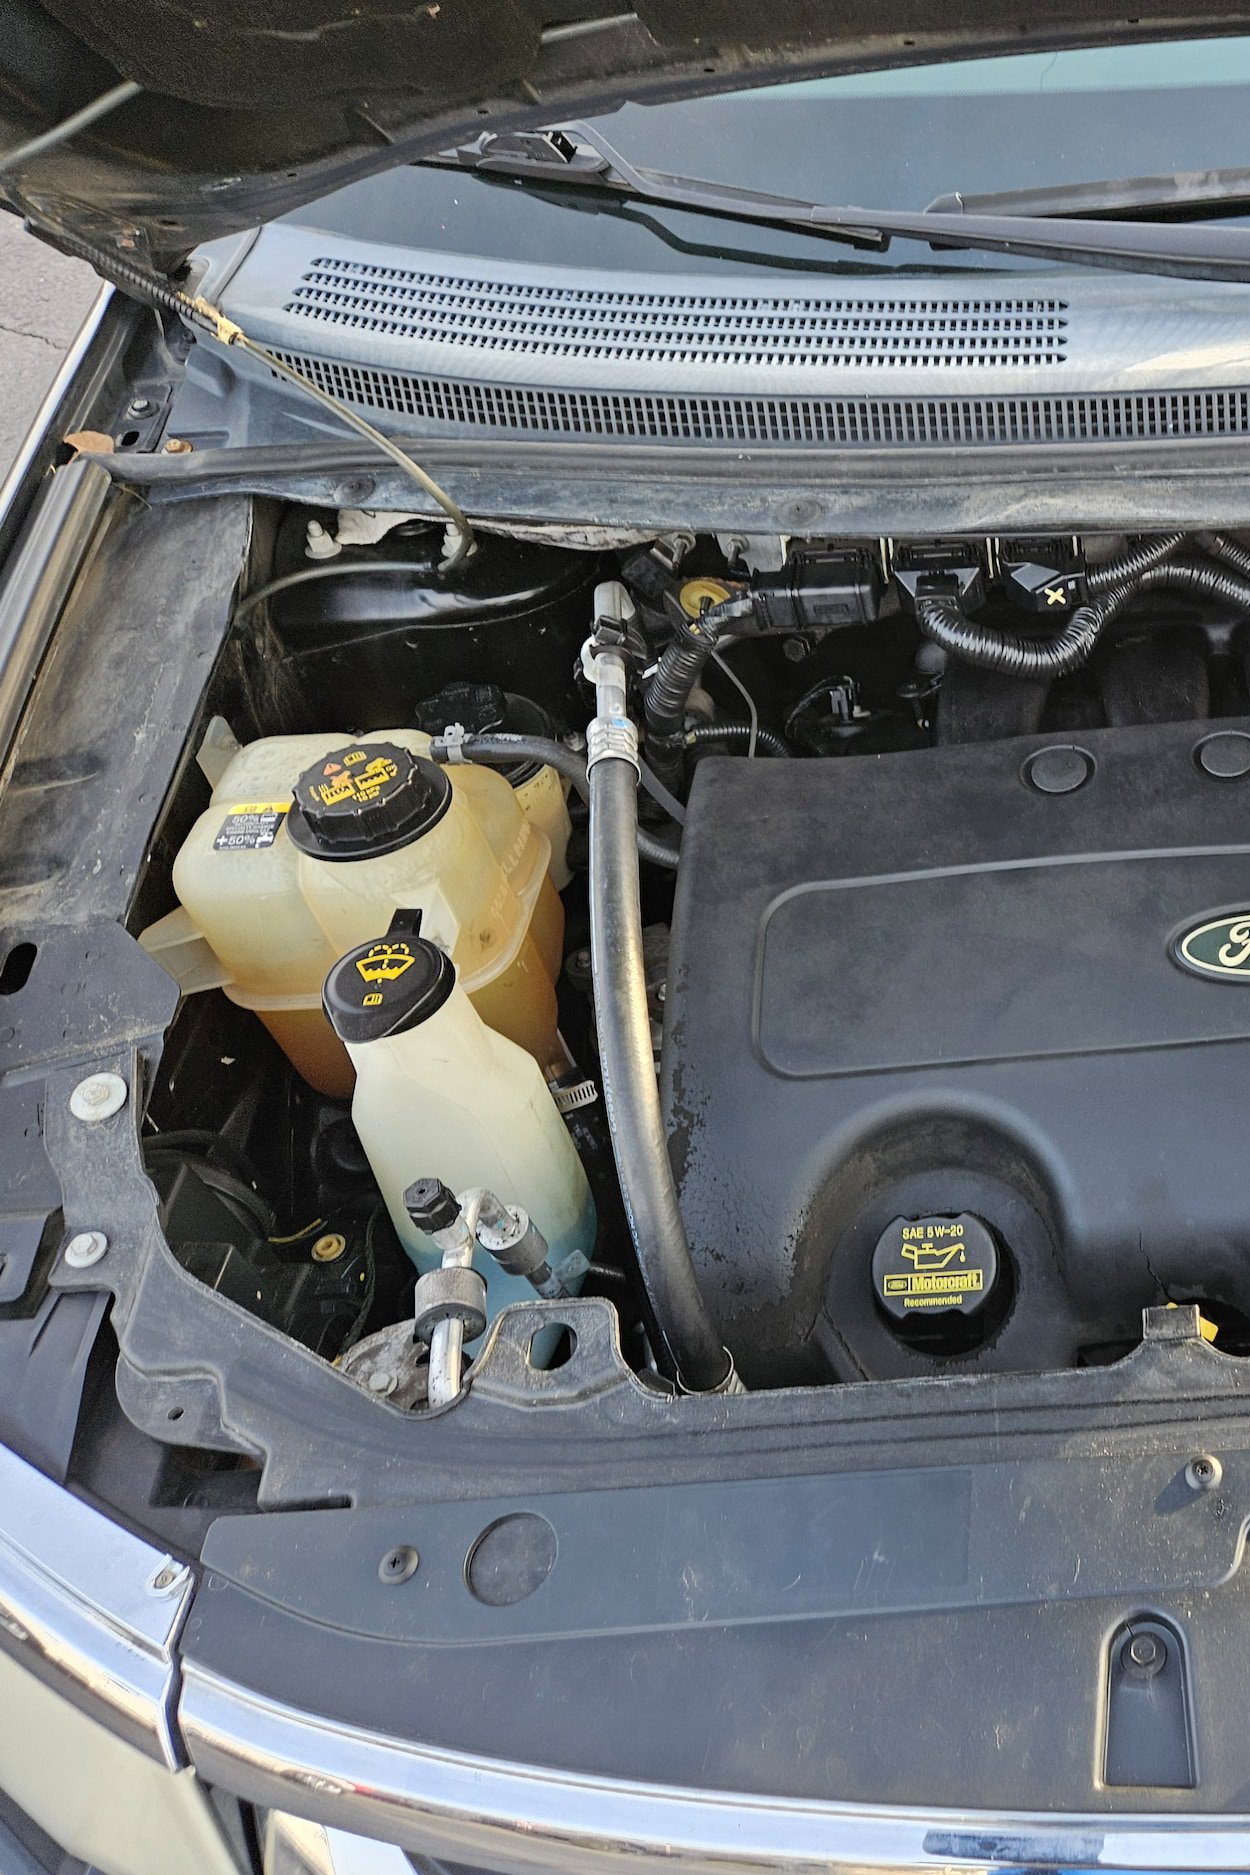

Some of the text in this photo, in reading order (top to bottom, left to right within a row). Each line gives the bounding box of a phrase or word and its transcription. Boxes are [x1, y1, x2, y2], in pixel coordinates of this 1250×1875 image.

[902, 1224, 964, 1240] SAE 5W-20
[911, 1273, 978, 1292] Motorcraft
[903, 1295, 963, 1308] Recommended
